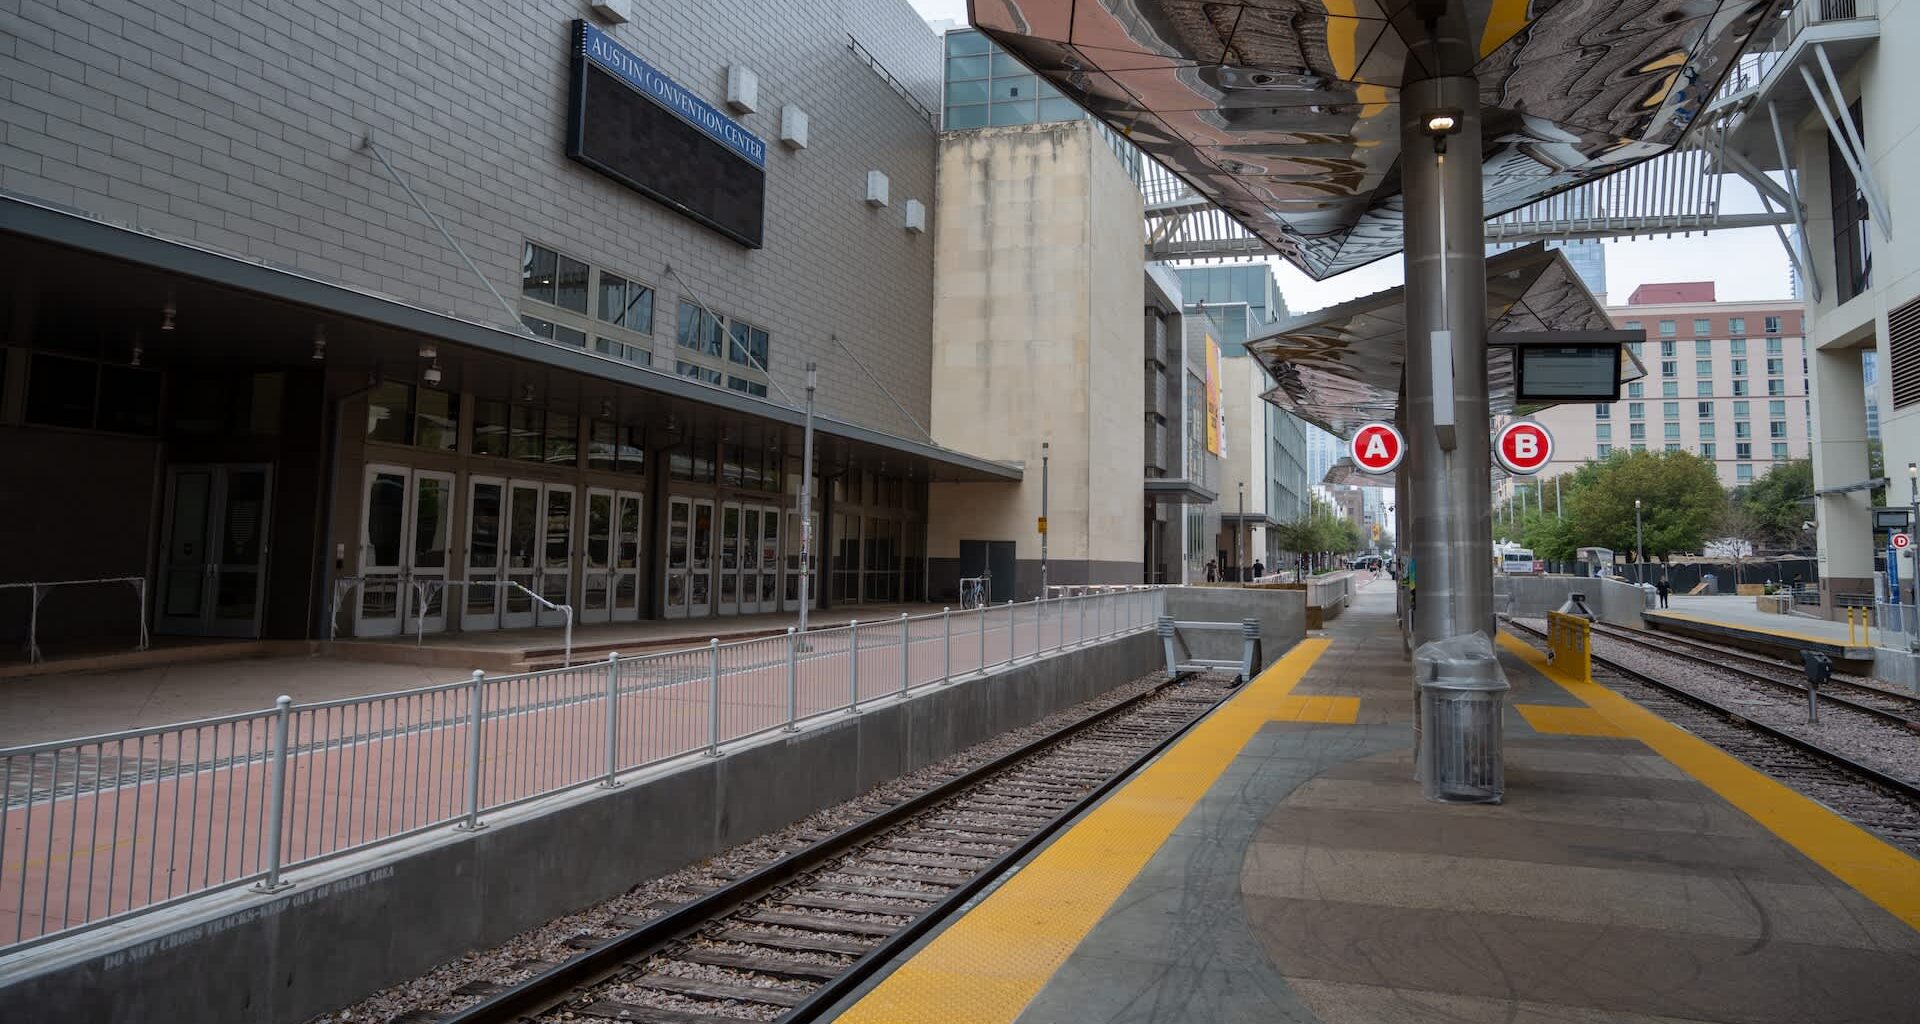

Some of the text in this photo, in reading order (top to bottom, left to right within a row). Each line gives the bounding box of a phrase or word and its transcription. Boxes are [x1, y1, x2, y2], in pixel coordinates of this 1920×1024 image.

[592, 37, 762, 160] AUSTIN CONVENTION CENTER
[1364, 433, 1389, 459] A
[1514, 433, 1539, 459] B
[103, 952, 125, 971] DO
[128, 941, 158, 963] NOT
[160, 928, 202, 951] CROSS
[293, 890, 314, 908] OUT
[317, 884, 330, 899] OF
[335, 874, 367, 893] TRACK
[368, 866, 395, 883] AREA
